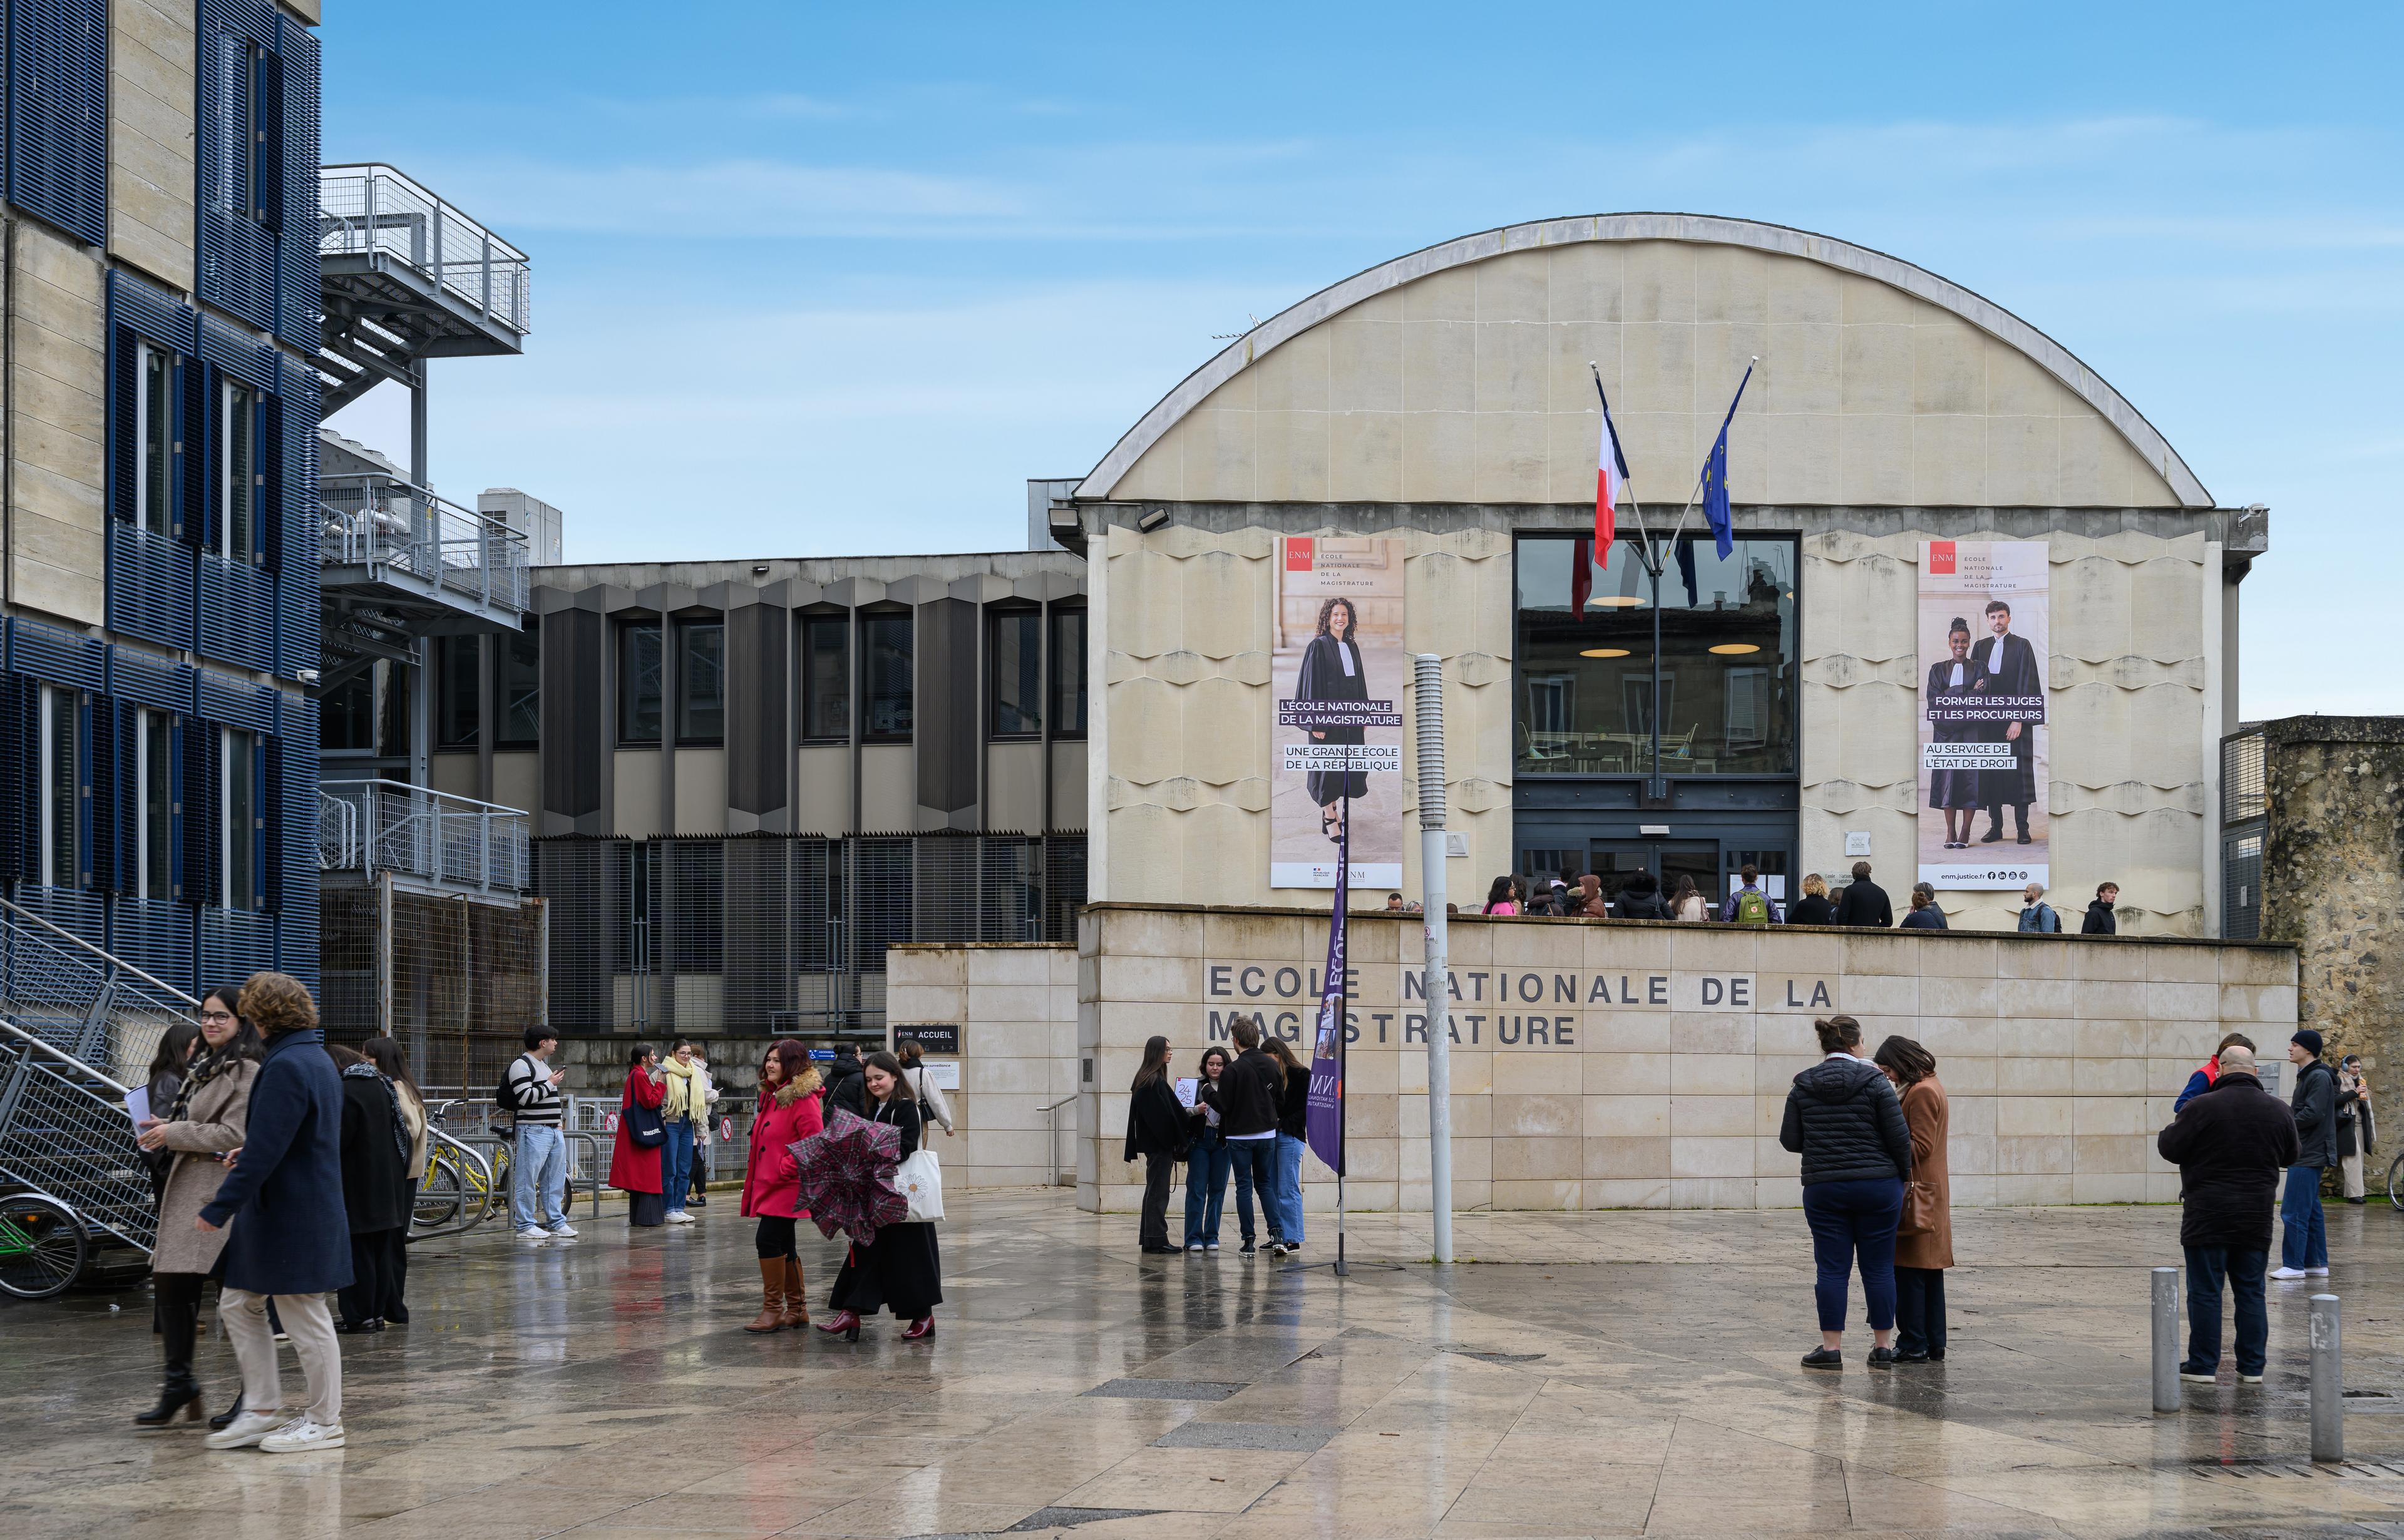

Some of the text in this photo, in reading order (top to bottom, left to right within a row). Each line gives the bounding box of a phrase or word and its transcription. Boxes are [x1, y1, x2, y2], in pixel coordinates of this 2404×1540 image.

[1289, 551, 1310, 559] ENM
[1281, 700, 1390, 712] L’ÉCOLE NATIONALE
[1936, 696, 2042, 706] FORMER LES JUGES
[1281, 715, 1400, 725] DE LA MAGISTRATURE
[1929, 711, 2042, 720] ET LES PROCUREURS
[1287, 746, 1398, 757] UNE GRANDE ÉCOLE
[1926, 745, 2008, 753] AU SERVICE DE
[1287, 759, 1398, 771] DE LA RÉPUBLIQUE
[1926, 757, 2014, 767] L’ÉTAT DE DROIT
[1210, 966, 1831, 1008] ECOLE NATIONALE DE LA
[1178, 1084, 1191, 1094] 24
[1180, 1093, 1192, 1104] 25
